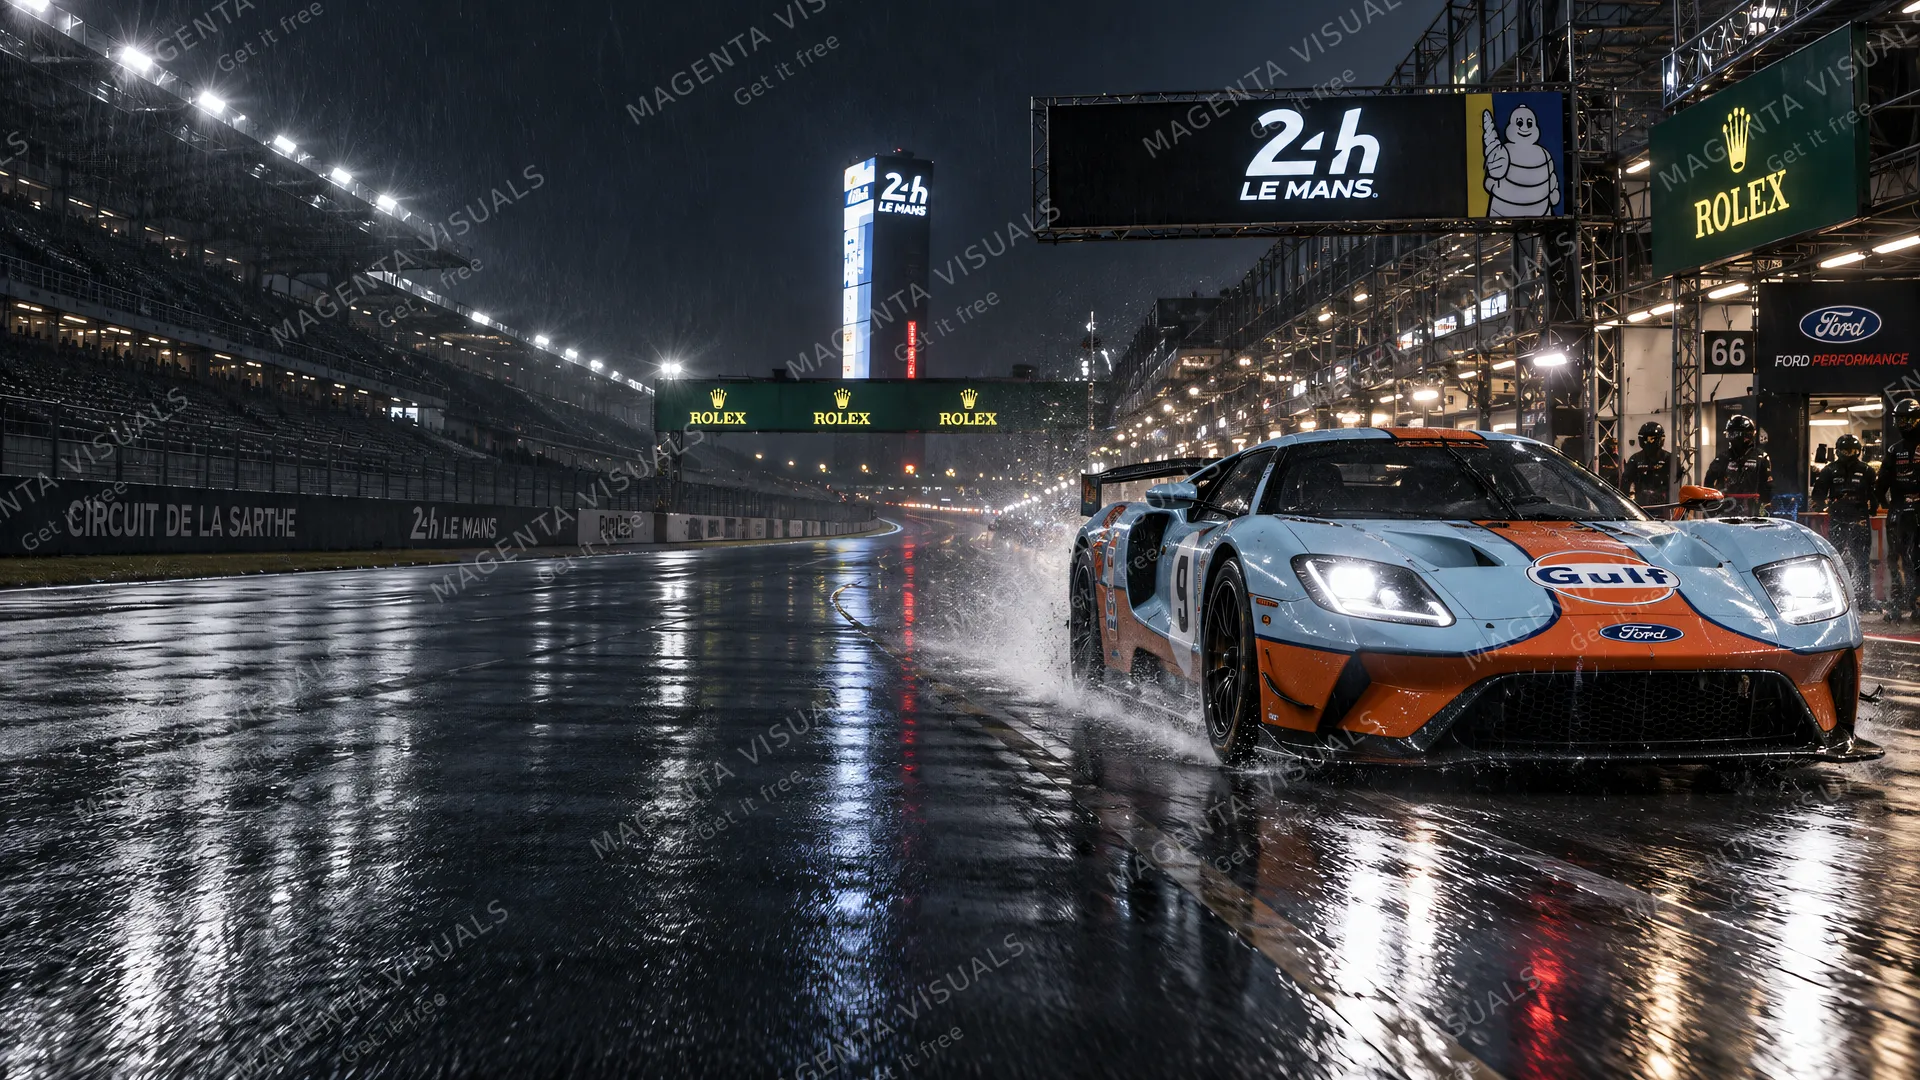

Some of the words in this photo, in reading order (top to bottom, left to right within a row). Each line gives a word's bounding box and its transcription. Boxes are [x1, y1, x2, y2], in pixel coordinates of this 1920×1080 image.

[1246, 108, 1380, 176] 24h
[881, 172, 928, 204] 24h
[1240, 181, 1280, 201] LE
[878, 201, 893, 212] LE
[894, 203, 927, 216] MANS
[1694, 169, 1790, 239] ROLEX
[1815, 311, 1868, 337] Ford
[1711, 338, 1746, 366] 66
[1775, 355, 1810, 367] FORD
[1811, 353, 1909, 366] PERFORMANCE
[689, 412, 747, 425] ROLEX
[814, 412, 871, 425] ROLEX
[939, 412, 997, 426] ROLEX
[67, 500, 160, 538] CIRCUIT
[166, 504, 193, 538] DE
[200, 505, 224, 538] LA
[228, 506, 297, 538] SARTHE
[410, 506, 439, 540] 24h
[443, 516, 459, 540] LE
[462, 516, 497, 540] MANS
[1536, 566, 1669, 585] Gulf
[1176, 555, 1189, 633] 9
[1618, 625, 1668, 640] Ford
